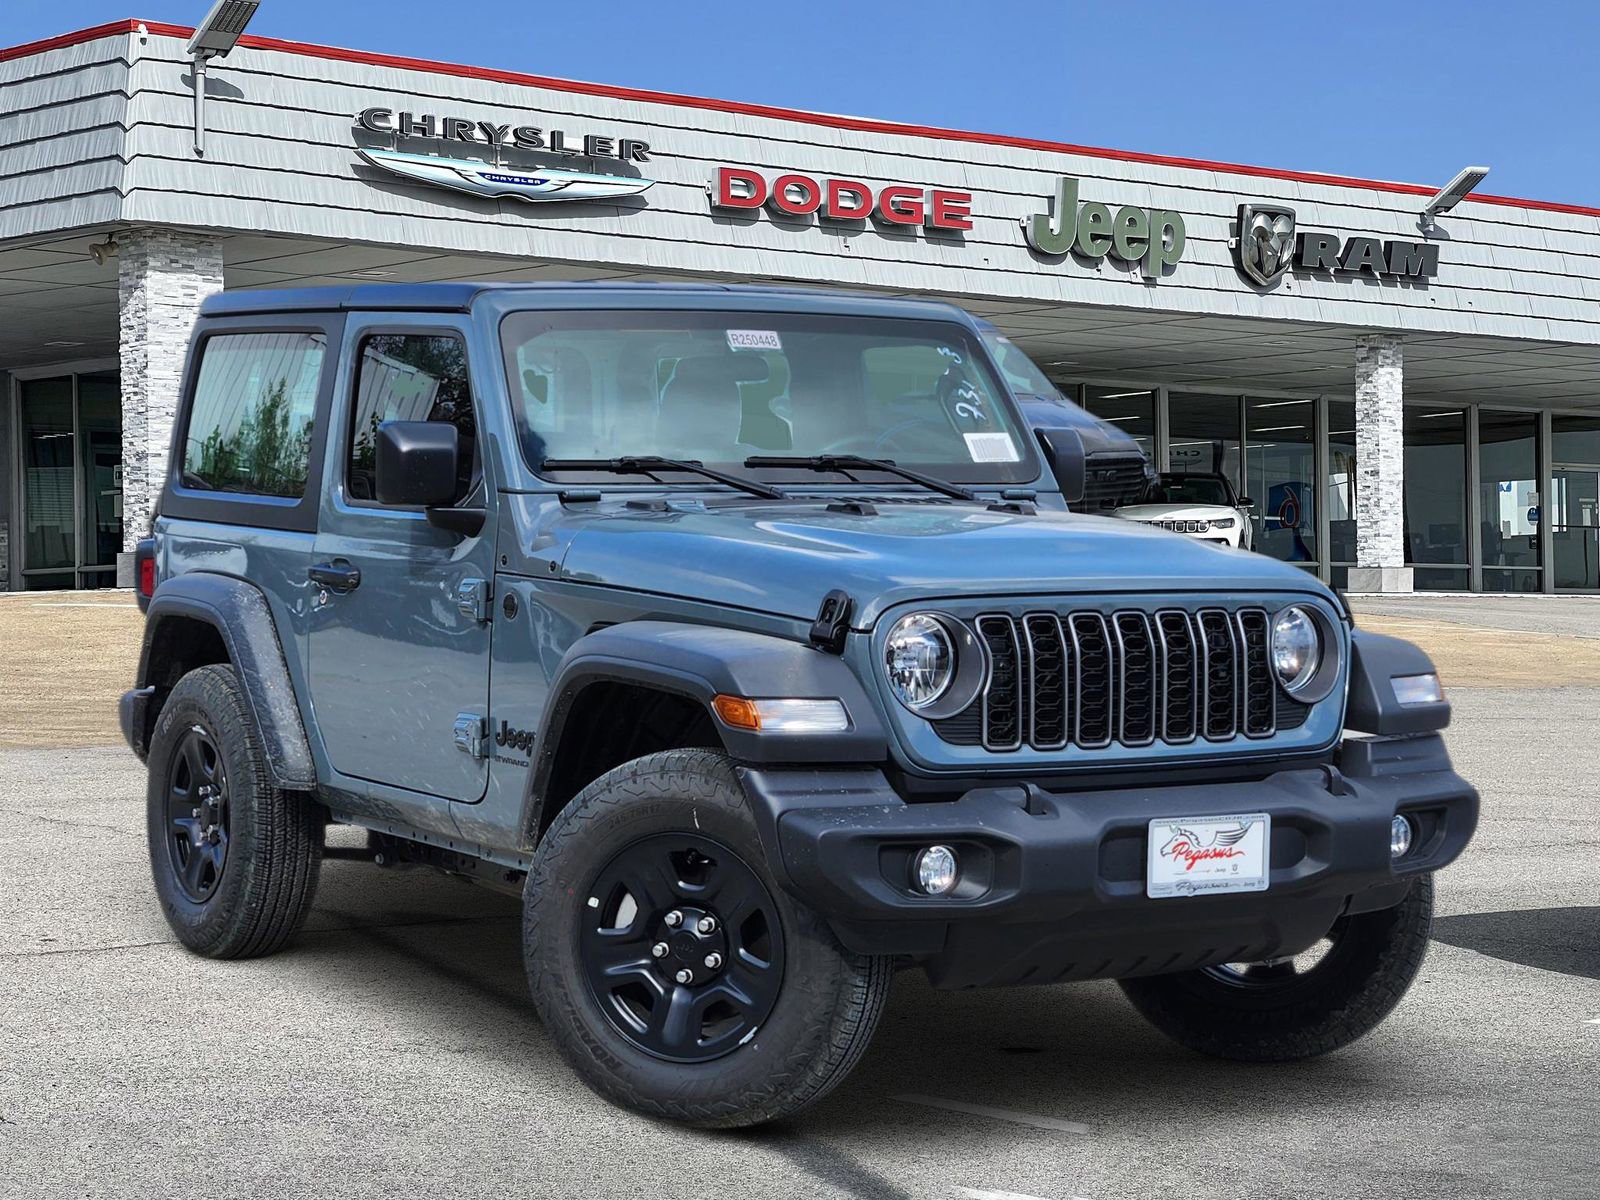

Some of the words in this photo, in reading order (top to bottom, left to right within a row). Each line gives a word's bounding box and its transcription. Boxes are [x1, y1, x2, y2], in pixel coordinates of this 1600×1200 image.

[359, 106, 650, 163] CHRYSLER
[484, 173, 541, 185] CHRYSLER
[712, 166, 973, 230] DODGE
[1028, 177, 1186, 278] Jeep
[1300, 231, 1440, 278] RAM
[731, 333, 778, 347] R250448
[1171, 841, 1245, 871] Pegasus
